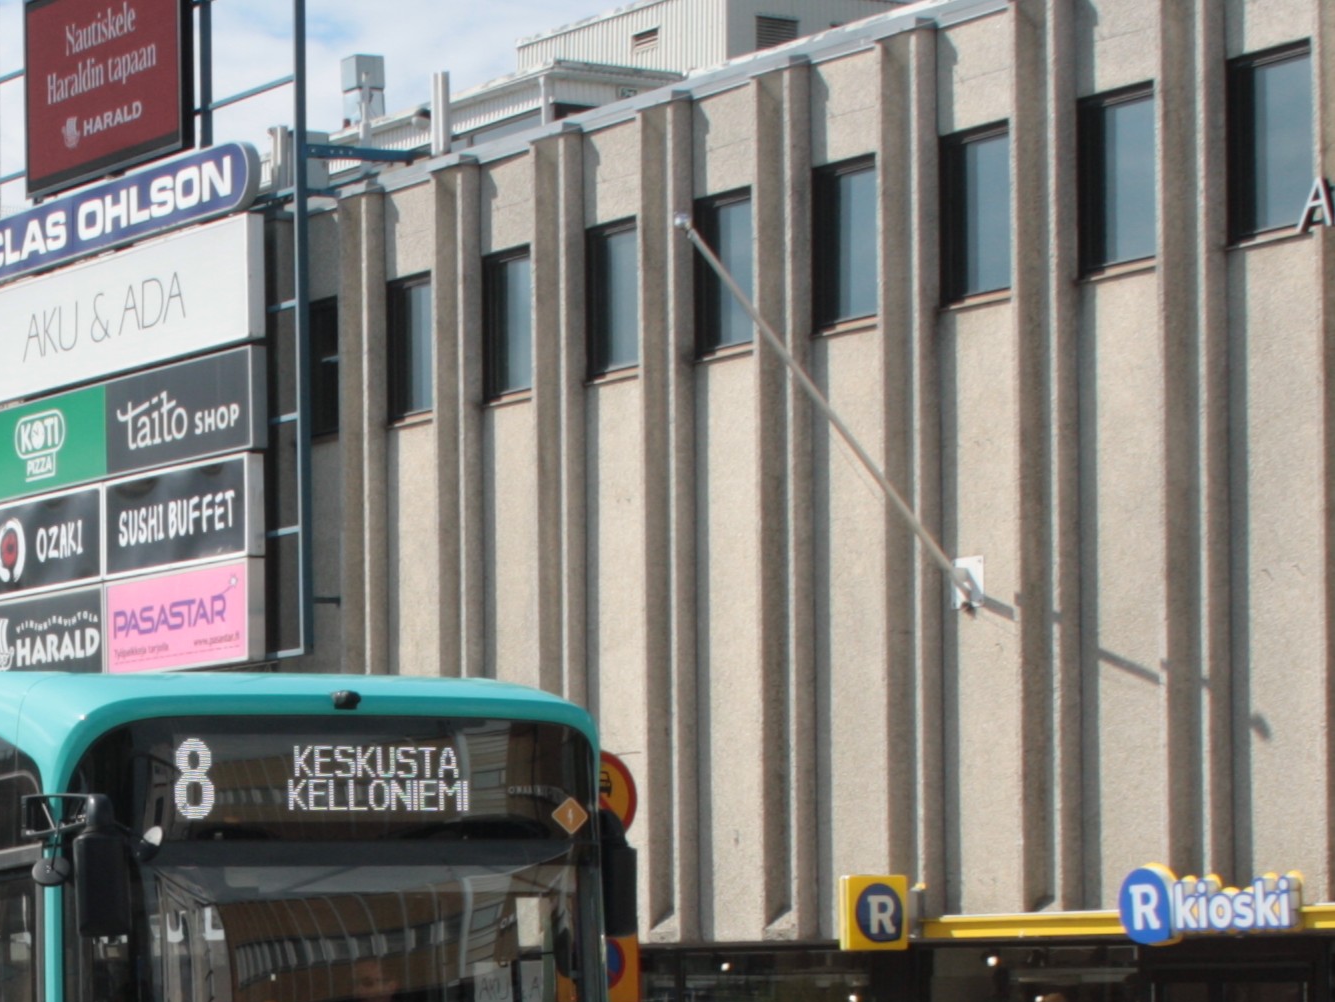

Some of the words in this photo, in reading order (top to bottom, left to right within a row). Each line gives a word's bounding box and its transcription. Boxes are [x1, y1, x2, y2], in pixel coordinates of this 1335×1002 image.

[66, 2, 136, 56] Nautiskele
[47, 59, 104, 105] Haraldin
[108, 43, 157, 85] tapaan
[83, 101, 143, 136] HARALD
[77, 155, 232, 241] OHLSON
[23, 300, 78, 363] AKU
[90, 292, 111, 343] &
[118, 271, 186, 336] ADA
[20, 417, 59, 453] KOTI
[117, 390, 189, 450] taito
[194, 403, 240, 435] SHOP
[26, 459, 54, 477] PIZZA
[36, 520, 84, 562] OZAKI
[118, 497, 165, 547] SUSHI
[168, 490, 236, 539] BUFFET
[113, 594, 226, 639] PASASTAR
[16, 627, 100, 667] HARALD
[174, 738, 215, 819] 8
[293, 745, 459, 778] KESKUSTA
[288, 779, 469, 811] KELLONIEMI
[867, 895, 896, 934] R
[1129, 884, 1161, 930] R
[1174, 876, 1290, 929] kioski
